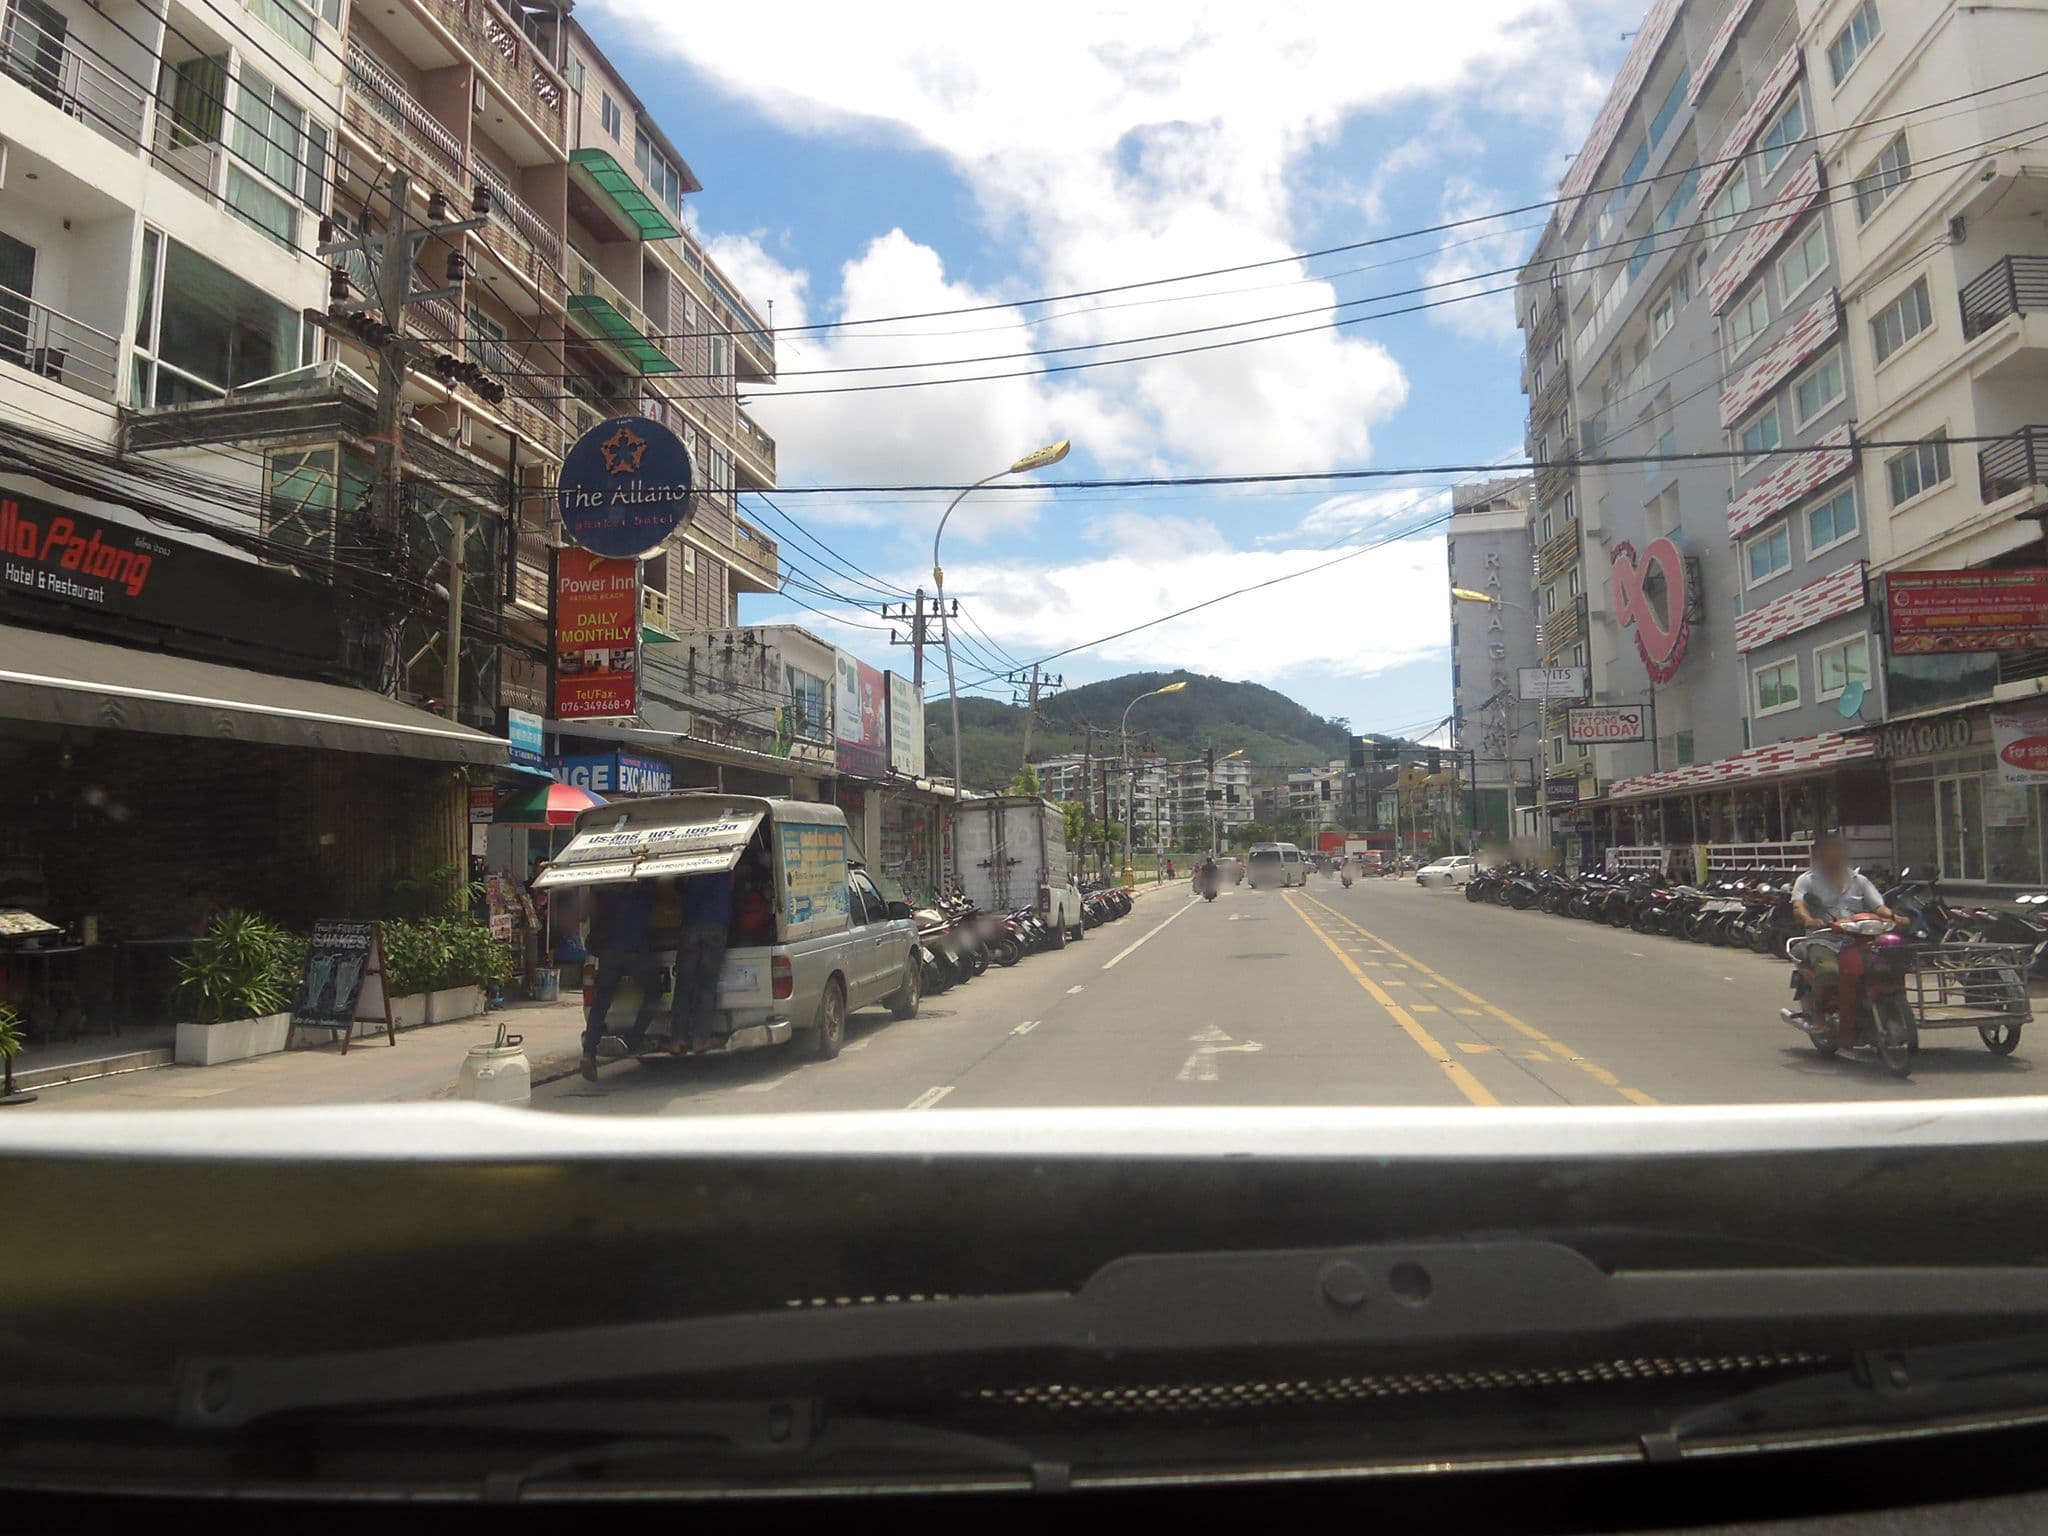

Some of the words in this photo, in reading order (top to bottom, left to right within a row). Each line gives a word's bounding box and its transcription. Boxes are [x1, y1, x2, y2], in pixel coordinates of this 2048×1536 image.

[560, 484, 602, 509] The
[38, 516, 152, 596] Patong
[5, 561, 34, 586] Hotel
[38, 571, 46, 589] &
[47, 573, 104, 603] Restaurant
[561, 577, 606, 593] Power
[611, 575, 635, 590] Inn
[577, 612, 618, 627] DAILY
[561, 627, 632, 643] MONTHLY
[576, 689, 617, 700] Tel/Fax:
[561, 700, 631, 712] 076-349668-9
[1571, 716, 1617, 726] PATONG
[1571, 724, 1640, 738] HOLIDAY
[619, 765, 673, 794] EXCHANGE
